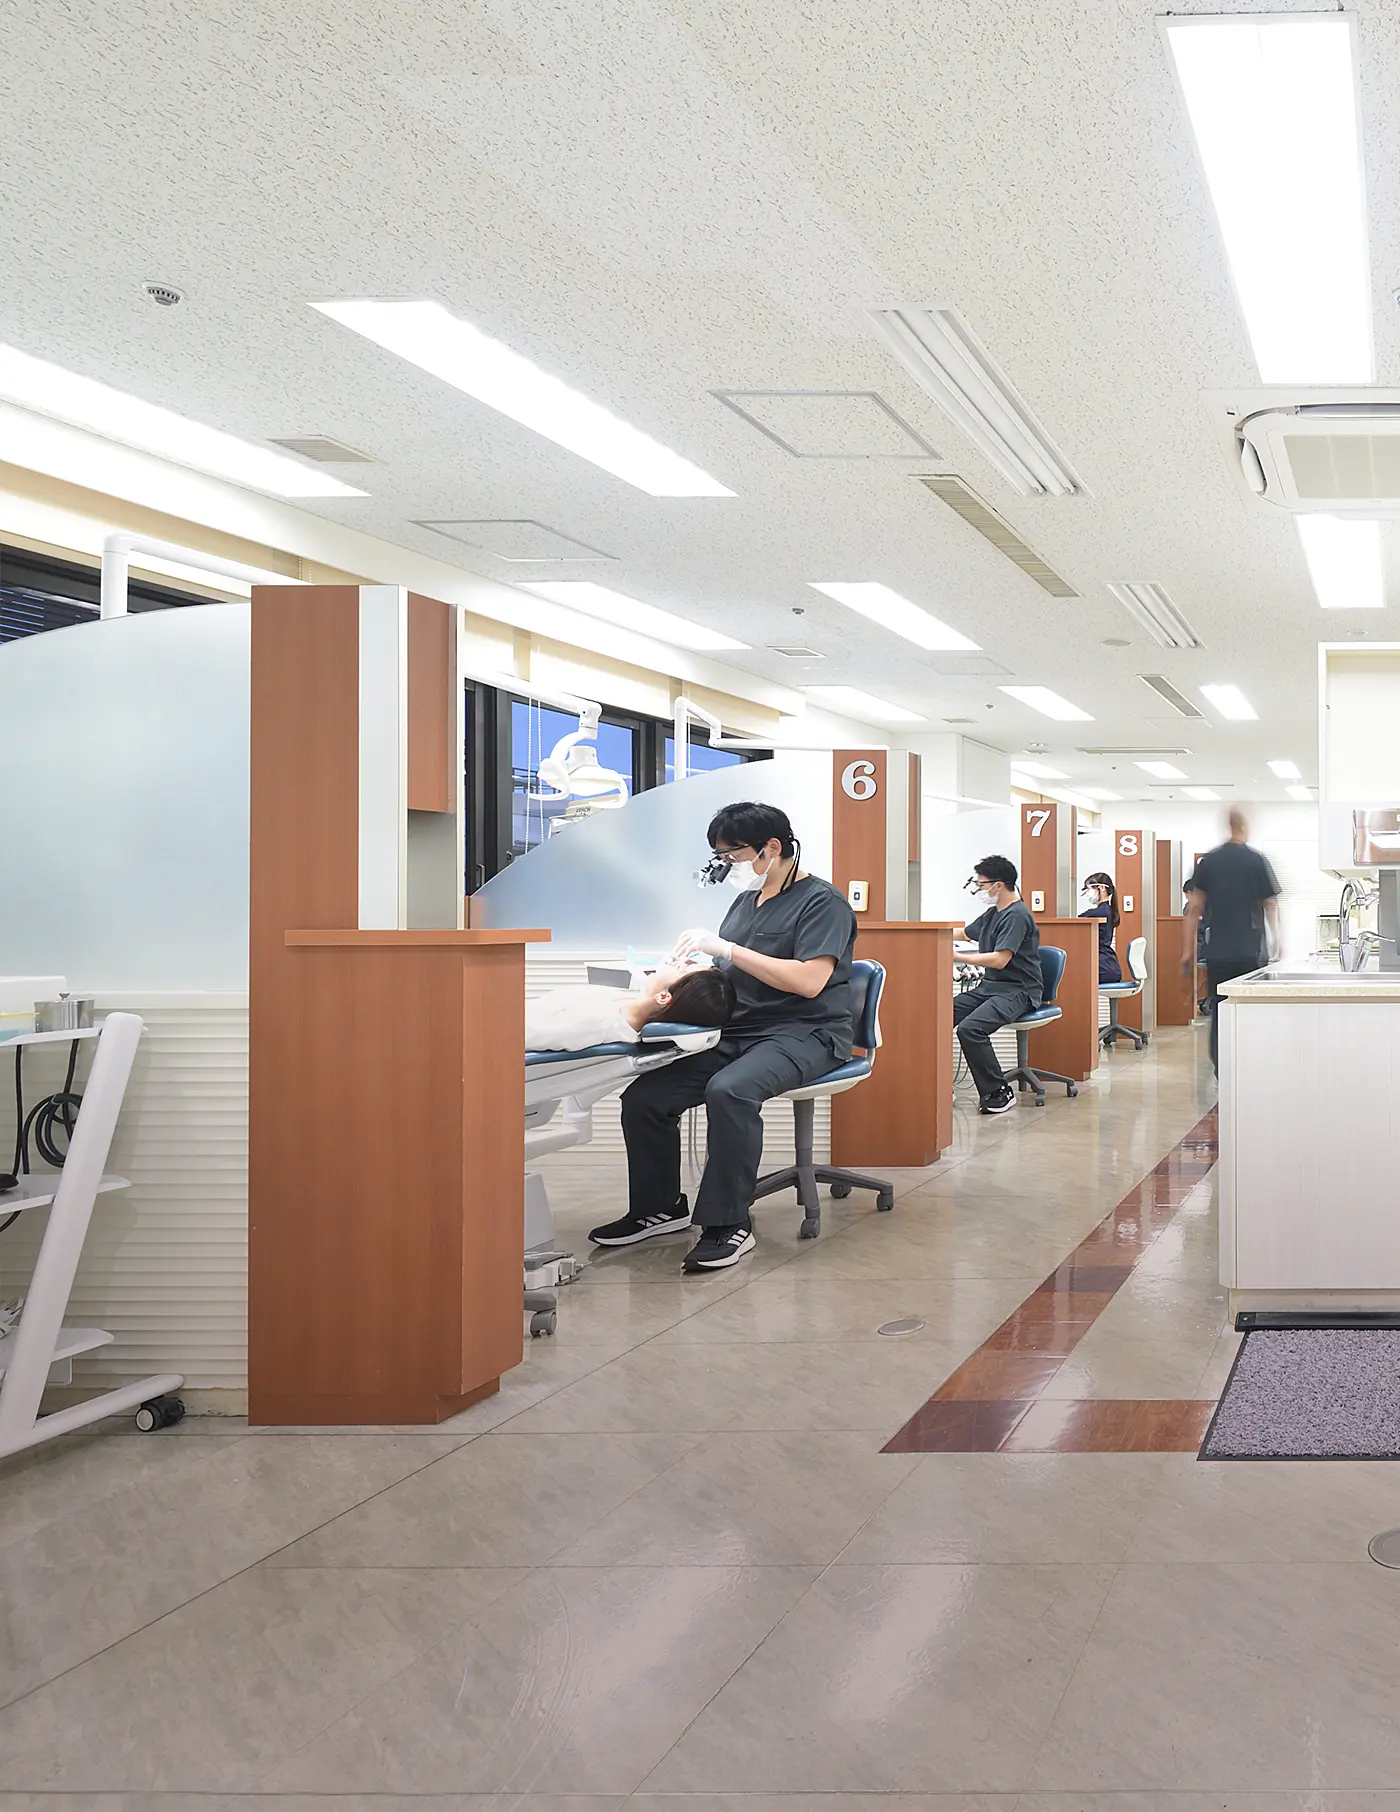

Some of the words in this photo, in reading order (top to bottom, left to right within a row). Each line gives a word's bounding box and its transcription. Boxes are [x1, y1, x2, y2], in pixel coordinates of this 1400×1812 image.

[842, 759, 877, 801] 6
[1026, 809, 1051, 837] 7
[1119, 834, 1138, 857] 8
